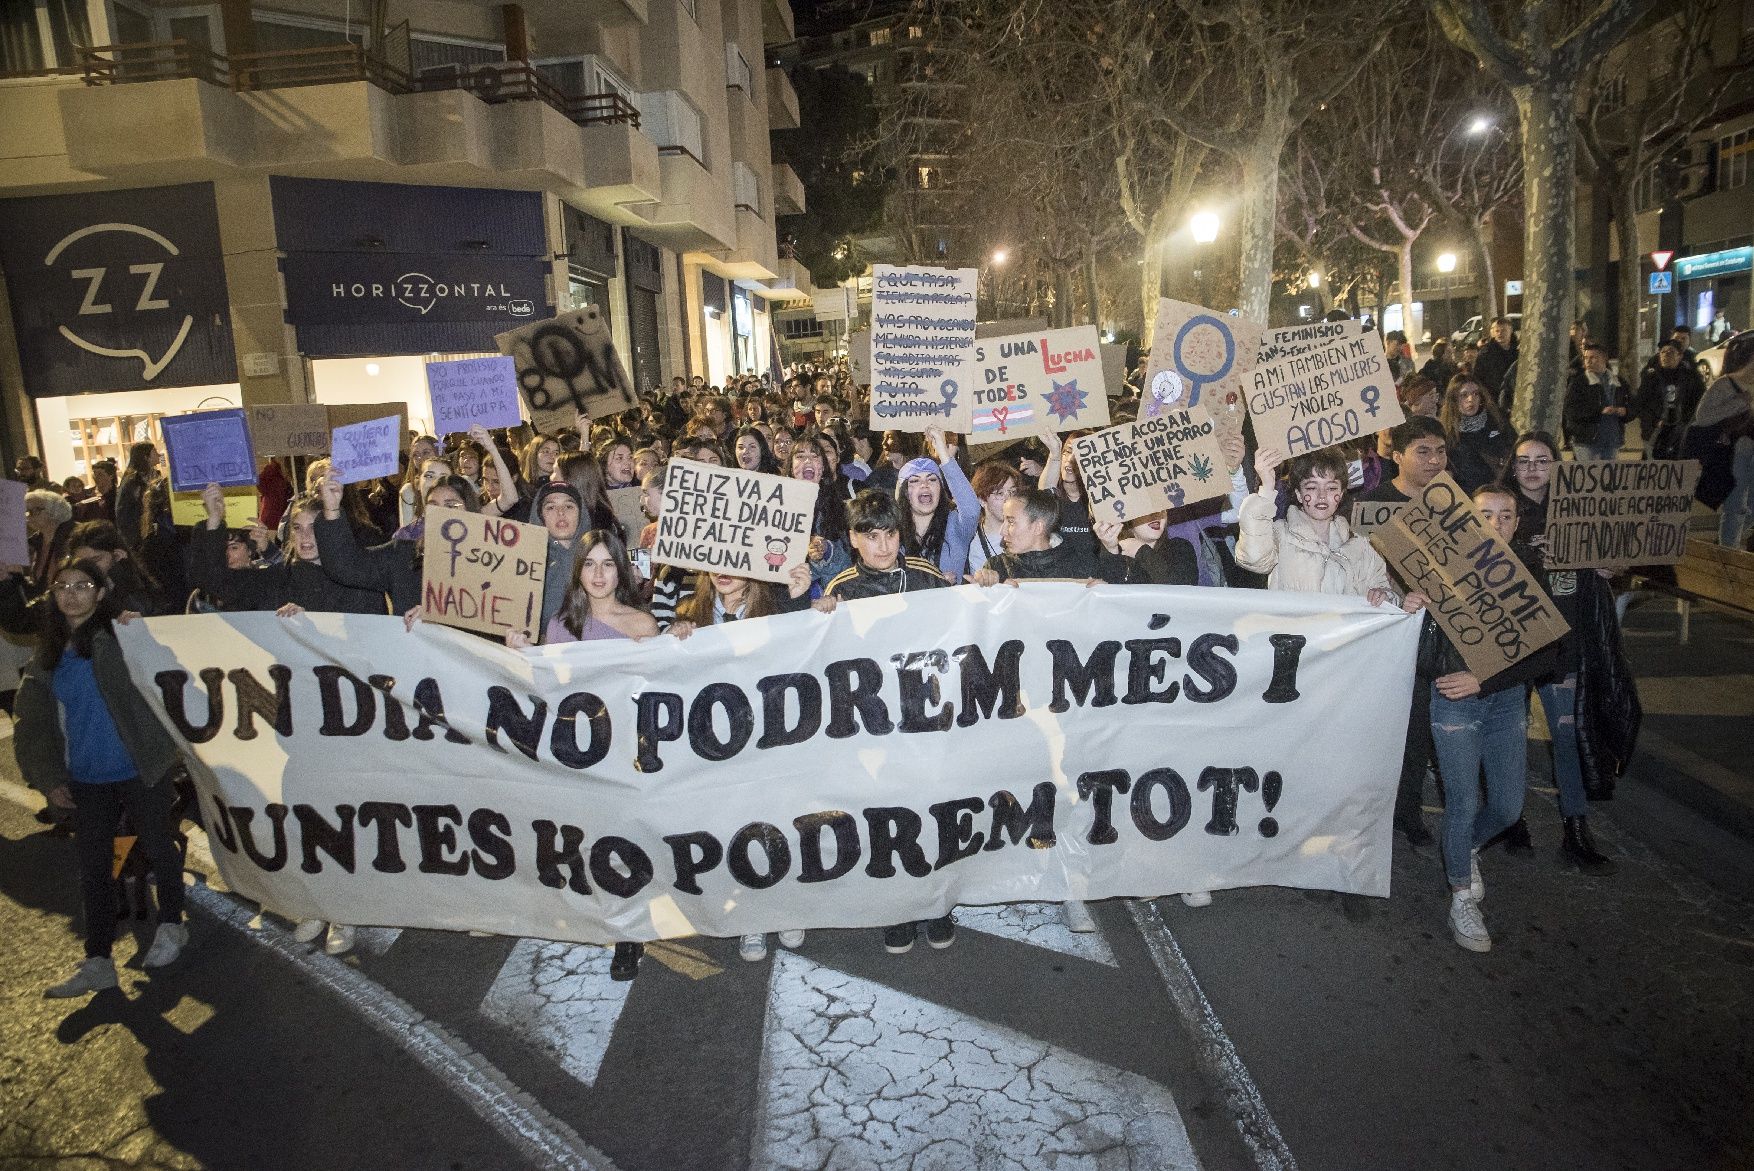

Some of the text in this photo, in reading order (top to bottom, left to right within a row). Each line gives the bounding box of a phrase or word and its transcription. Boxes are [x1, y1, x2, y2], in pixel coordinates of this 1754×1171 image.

[332, 283, 511, 298] HORIZZONTAL
[1274, 324, 1344, 344] FEMINISMO
[1349, 338, 1369, 358] ME
[1000, 340, 1038, 359] UNA
[1040, 338, 1096, 375] LUCHA
[984, 365, 1009, 385] DE
[1250, 355, 1382, 415] GUSTAN LAS MUJERES
[974, 383, 1028, 405] TODES
[1076, 410, 1191, 458] SI TE ACOSAN
[1080, 422, 1213, 474] PRENDE UN PORRO
[1287, 408, 1360, 456] ACOSO
[1139, 444, 1185, 470] VIENE
[669, 465, 785, 505] FELIZ VA A
[1090, 485, 1115, 505] LA
[1556, 462, 1684, 496] NOS QUITARON
[665, 489, 807, 534] SER EL DIA QUE
[1552, 494, 1693, 519] TANTO QUE ACABARON
[483, 519, 521, 548] NO
[660, 516, 756, 548] NO FALTE
[465, 548, 543, 582] SOY DE
[657, 539, 752, 571] NINGUNA
[1423, 482, 1551, 633] QUE NO ME
[1400, 548, 1485, 646] BESUGO
[1453, 571, 1530, 661] PIROPOS
[154, 663, 293, 743] UN
[484, 686, 613, 770] NO
[632, 639, 1027, 774] PODREM
[1046, 612, 1240, 714] MÉS
[1262, 633, 1307, 704] I
[531, 818, 655, 899] HO
[663, 780, 1057, 896] PODREM
[1075, 765, 1284, 847] TOT!
